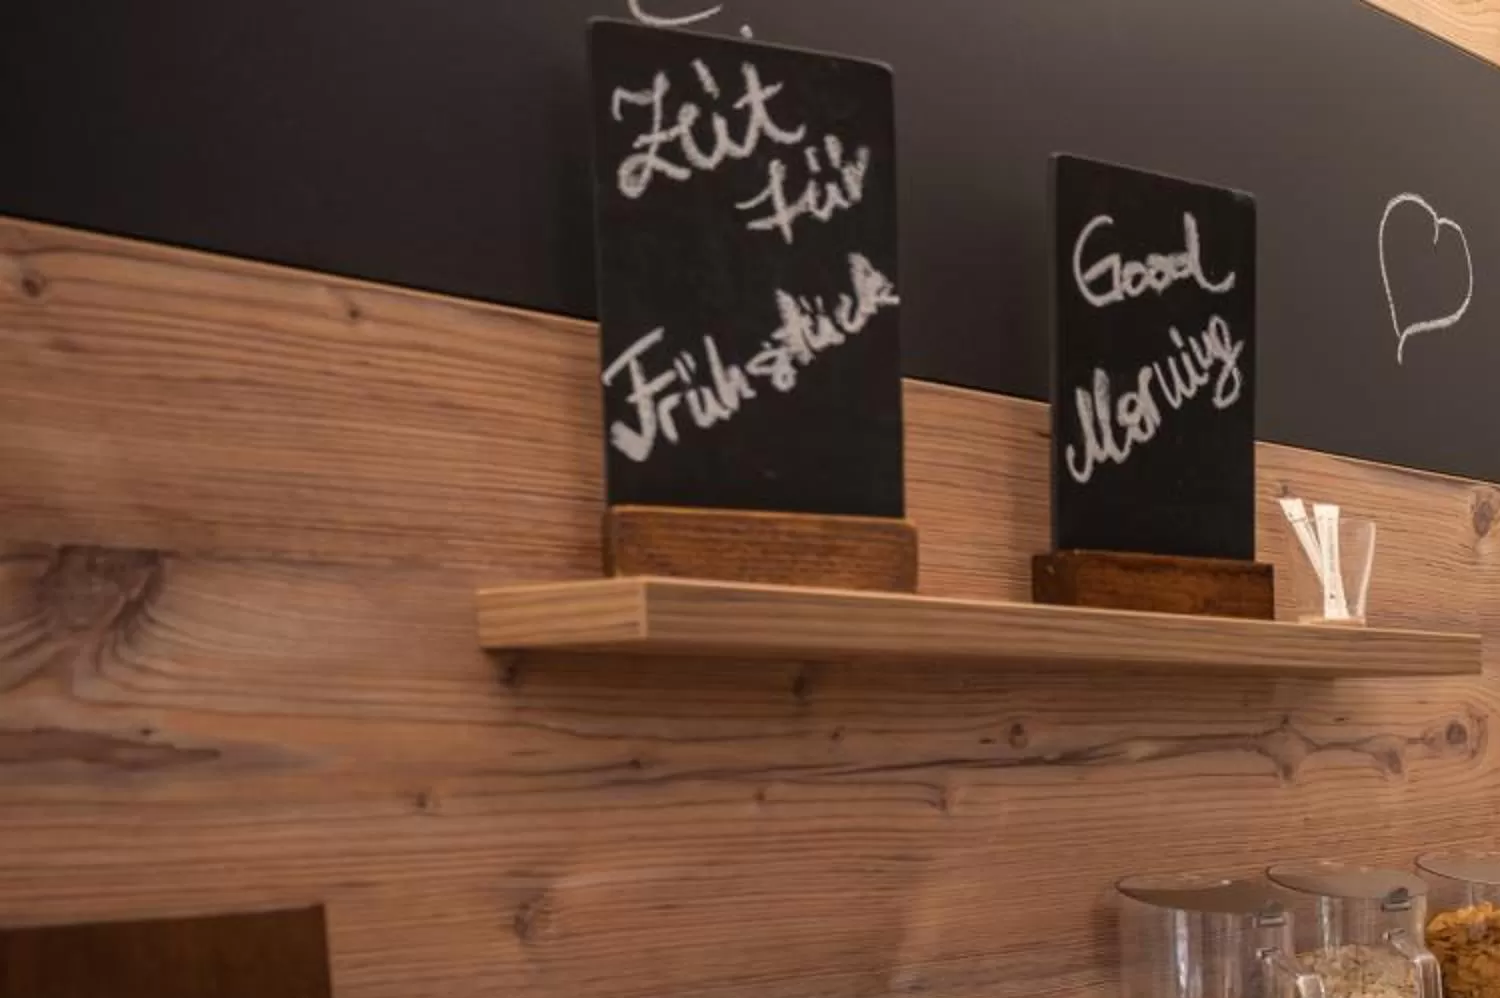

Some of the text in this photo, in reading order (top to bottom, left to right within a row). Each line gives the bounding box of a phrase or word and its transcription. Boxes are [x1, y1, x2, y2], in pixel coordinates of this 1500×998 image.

[612, 60, 806, 198] Zeit
[735, 135, 870, 243] für
[1072, 211, 1236, 307] Good
[1065, 315, 1244, 483] Morning
